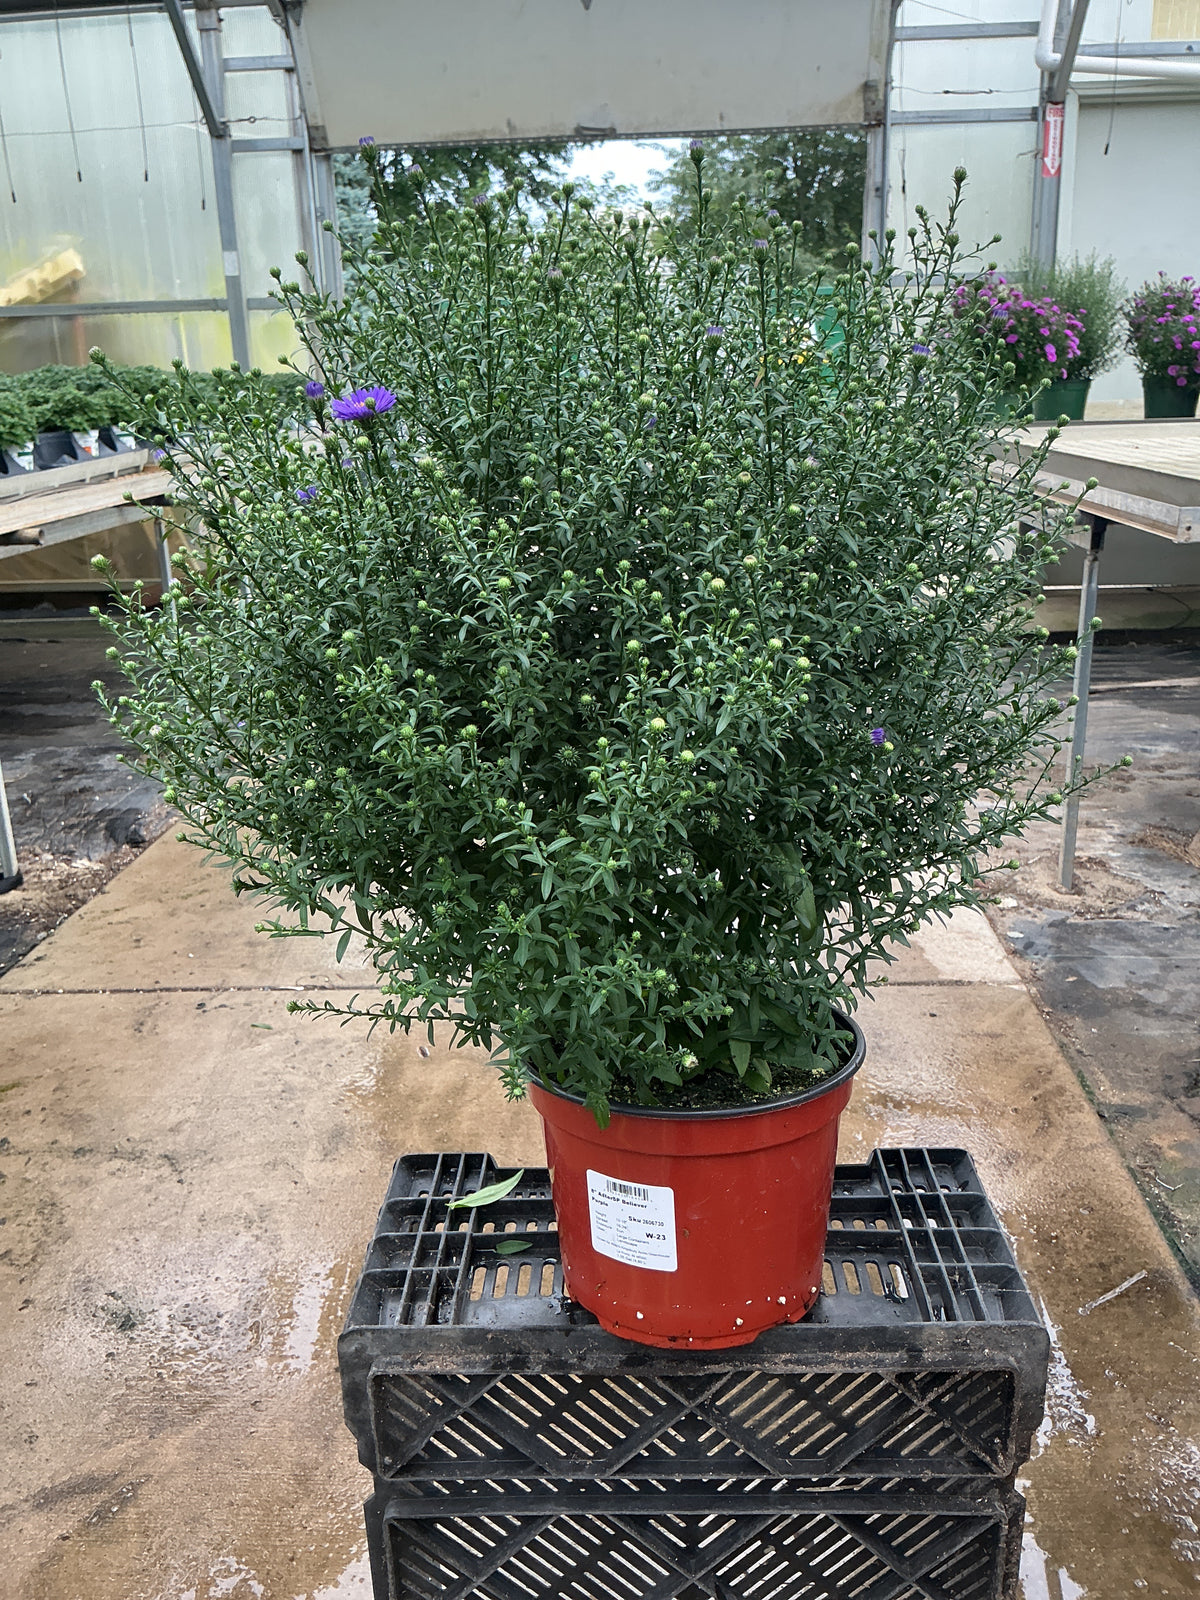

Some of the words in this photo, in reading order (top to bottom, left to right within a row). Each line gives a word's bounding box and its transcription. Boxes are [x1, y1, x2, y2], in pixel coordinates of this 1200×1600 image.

[591, 1196, 609, 1207] Purple
[621, 1199, 647, 1209] Believer
[628, 1215, 641, 1223] Sku
[645, 1232, 666, 1241] W-23
